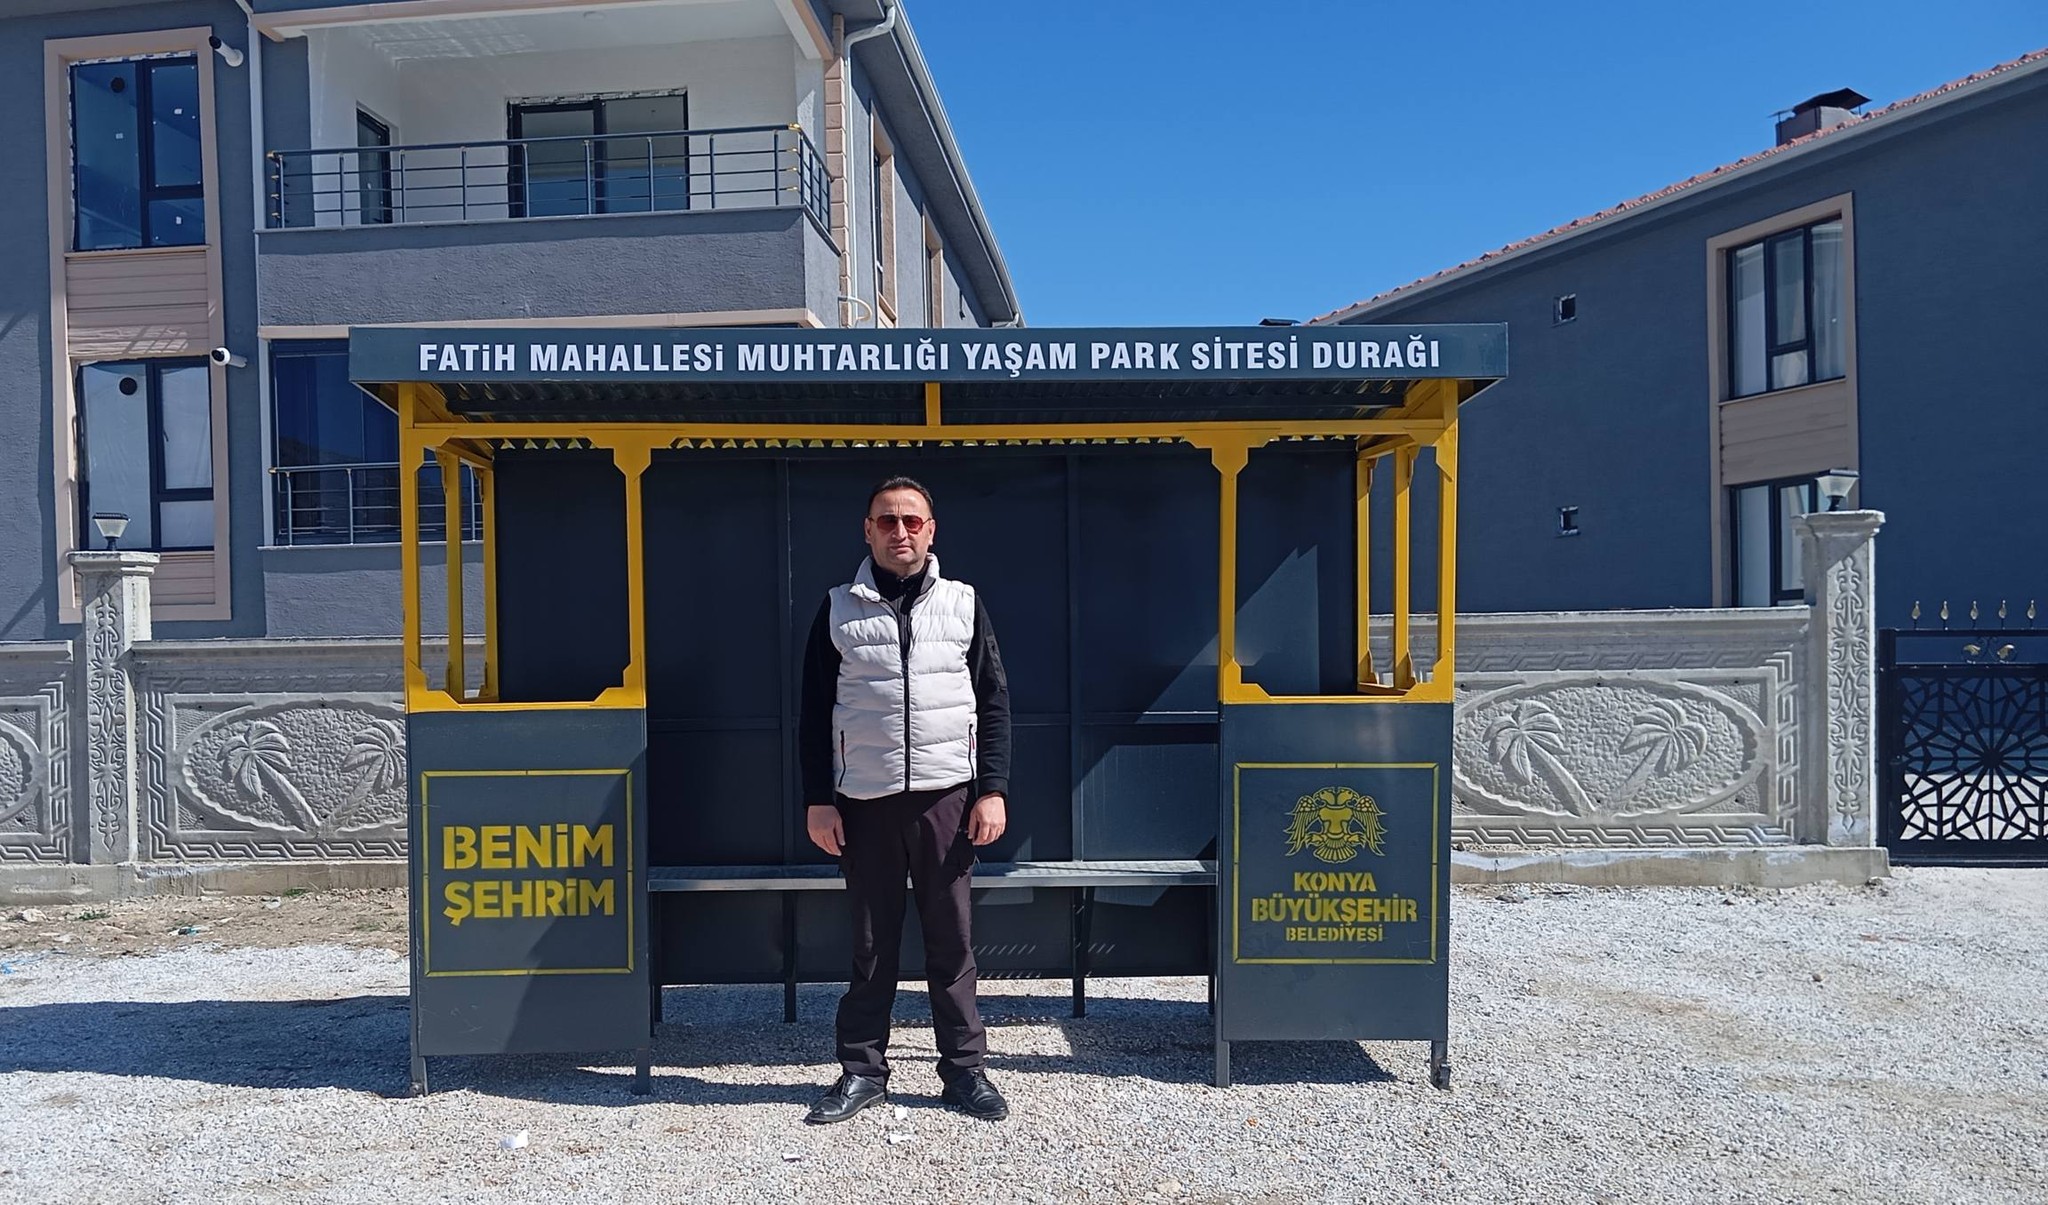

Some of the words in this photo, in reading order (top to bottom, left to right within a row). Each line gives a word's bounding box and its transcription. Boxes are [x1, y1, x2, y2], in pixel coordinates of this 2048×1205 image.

[738, 337, 949, 372] MUHTARLIĞI
[961, 342, 1077, 378] YAŞAM
[1091, 342, 1180, 370] PARK
[1191, 335, 1299, 370] SİTESİ
[1312, 334, 1440, 369] DURAĞI
[1293, 872, 1377, 892] KONYA
[1251, 893, 1418, 926] BÜYÜKŞEHİR
[1285, 923, 1383, 942] BELEDİYESİ
